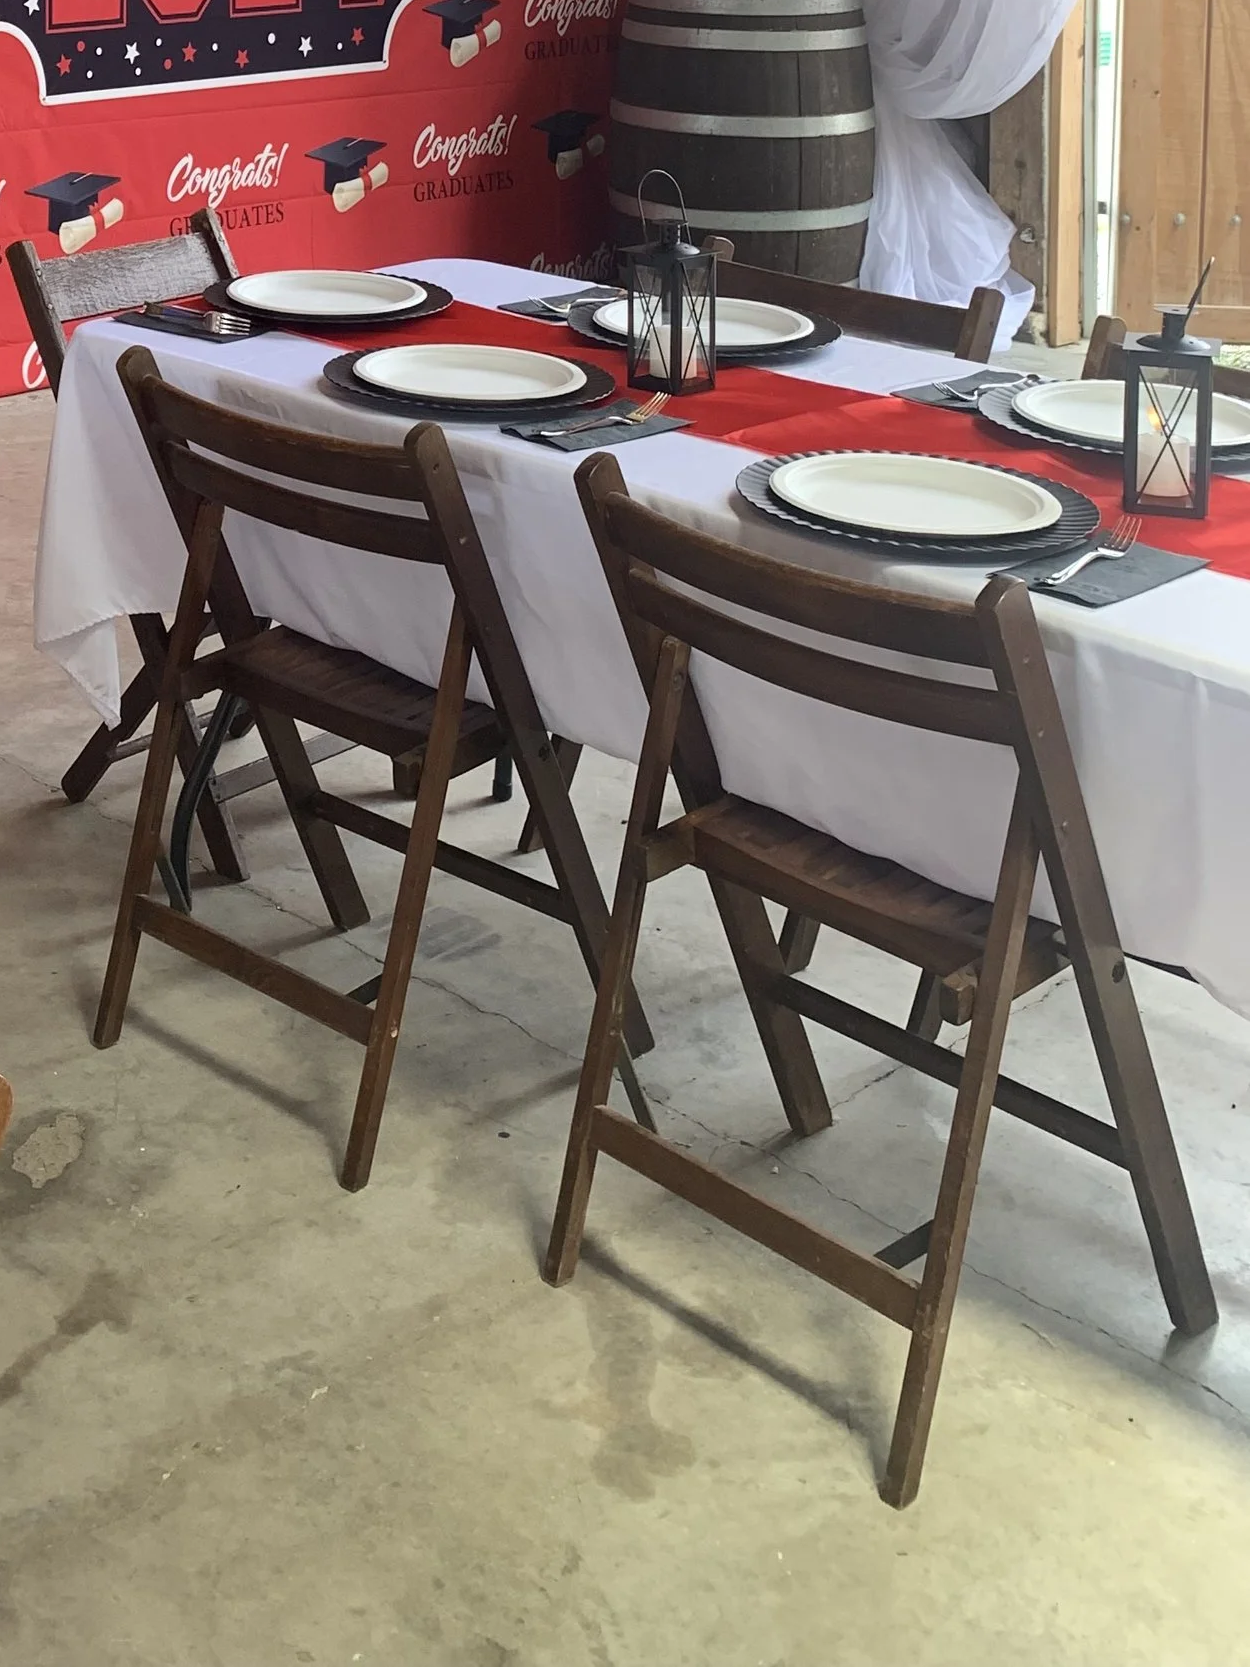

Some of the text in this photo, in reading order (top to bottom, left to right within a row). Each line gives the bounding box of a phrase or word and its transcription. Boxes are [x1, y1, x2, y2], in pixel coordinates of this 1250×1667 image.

[166, 142, 289, 209] Congrats!
[412, 114, 519, 177] Congrats!
[413, 167, 515, 203] GRADUATES
